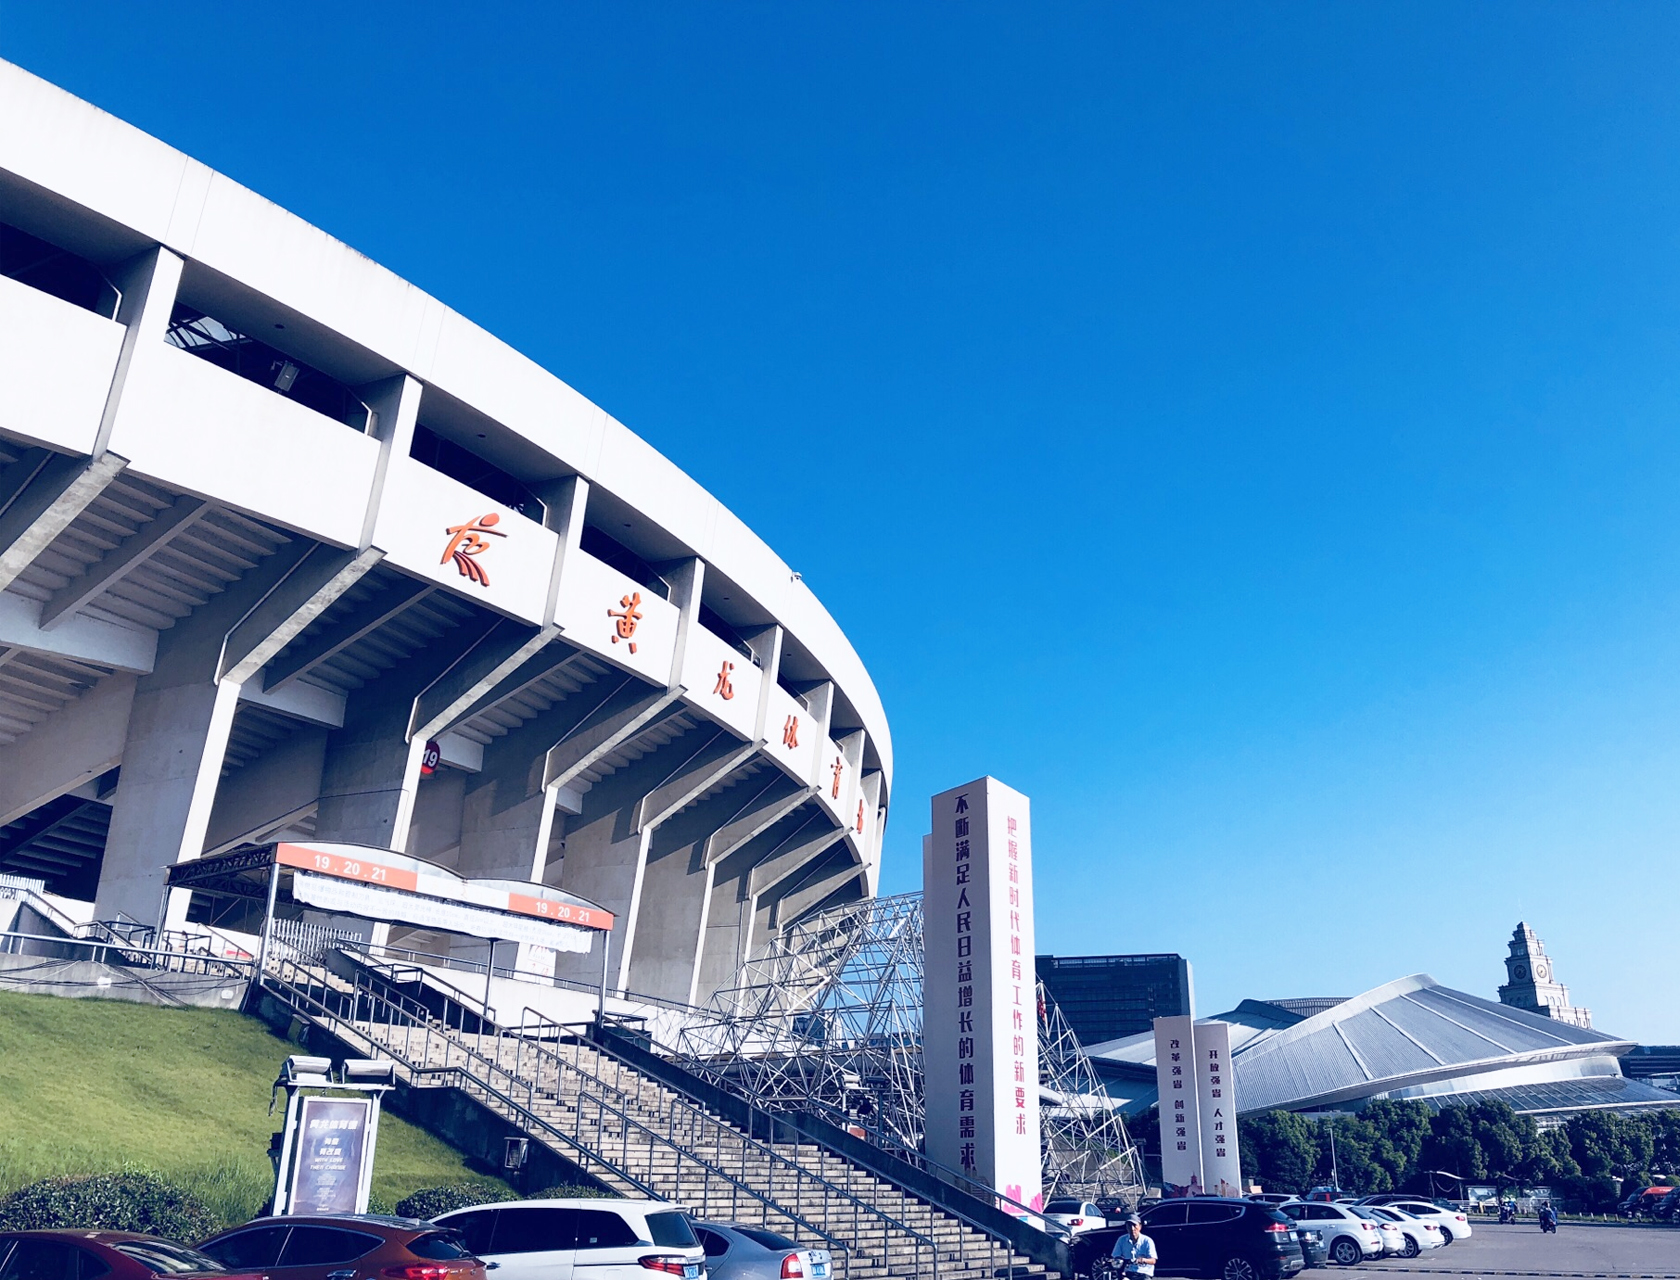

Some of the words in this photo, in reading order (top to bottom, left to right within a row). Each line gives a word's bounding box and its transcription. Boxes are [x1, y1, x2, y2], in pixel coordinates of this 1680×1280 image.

[954, 793, 977, 1172] 不断满足人民日益增长的体育需求
[1007, 815, 1026, 1136] 把握新时代体育工作的新要求
